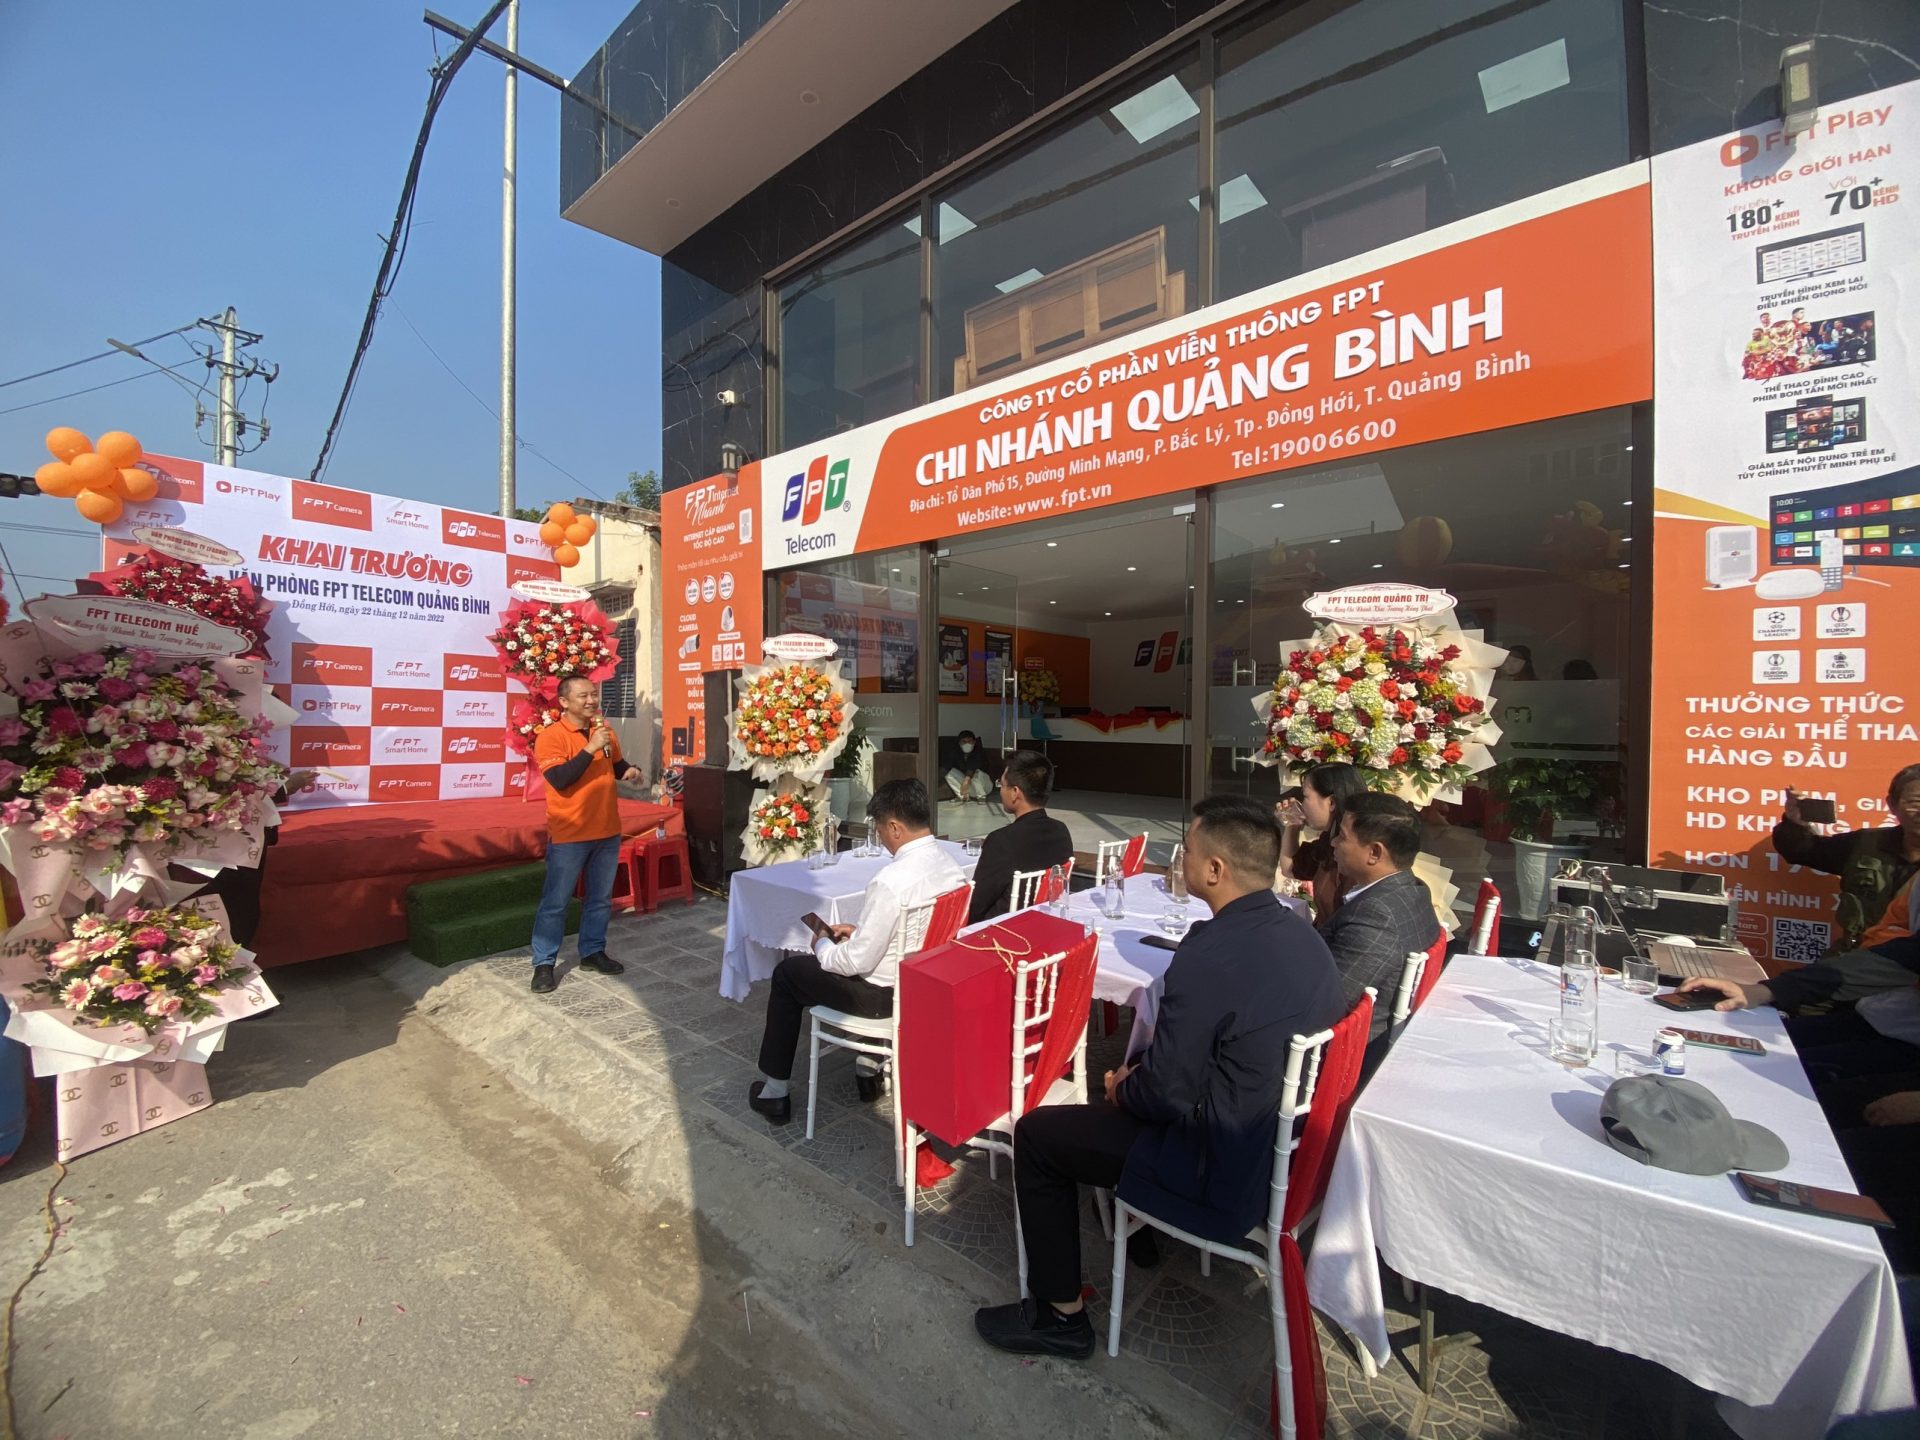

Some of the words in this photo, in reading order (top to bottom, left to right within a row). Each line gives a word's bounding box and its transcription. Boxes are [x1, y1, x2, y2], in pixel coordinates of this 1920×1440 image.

[1828, 105, 1893, 134] Play
[1724, 170, 1793, 196] KHÔNG
[1799, 155, 1842, 176] GIỚI
[1849, 143, 1892, 163] HẠN
[1873, 194, 1899, 207] HD
[1825, 279, 1846, 289] XEM
[979, 392, 1033, 424] CÔNG
[1036, 385, 1058, 408] TY
[1060, 364, 1092, 399] CỔ
[1099, 351, 1159, 389] PHẦN
[1165, 330, 1217, 368] VIỄN
[1226, 301, 1323, 350] THÔNG
[1332, 280, 1385, 317] FPT
[915, 444, 967, 488] CHI
[976, 401, 1113, 474] NHÁNH
[1127, 343, 1310, 433] QUẢNG
[1333, 287, 1504, 382] BÌNH
[1784, 379, 1811, 390] THAO
[1841, 371, 1865, 380] CAO
[1753, 393, 1777, 402] PHIM
[1780, 390, 1803, 399] BOM
[947, 485, 959, 504] Tổ
[962, 480, 983, 502] Dân
[985, 474, 1006, 498] Phố
[1007, 474, 1024, 492] 15,
[1025, 465, 1065, 488] Đường
[1069, 455, 1101, 477] Minh
[1105, 446, 1150, 473] Mạng,
[1154, 439, 1168, 457] P.
[1170, 426, 1199, 452] Bắc
[1205, 423, 1231, 446] Lý,
[1234, 418, 1263, 438] Tp.
[1266, 402, 1314, 429] Đồng
[1320, 391, 1361, 416] Hới,
[1364, 386, 1383, 406] T.
[1387, 367, 1462, 402] Quảng
[1475, 350, 1531, 381] Bình
[1819, 452, 1849, 462] DUNG
[1871, 448, 1885, 456] EM
[1830, 460, 1857, 469] MINH
[233, 485, 255, 496] FPT
[257, 489, 281, 502] Play
[782, 454, 851, 526] FPT
[685, 484, 716, 511] FPT
[712, 485, 740, 502] Internet
[302, 497, 335, 509] FPT
[334, 503, 363, 515] Camera
[136, 510, 174, 522] FPT
[386, 516, 407, 527] Smart
[408, 520, 430, 530] Home
[394, 510, 422, 522] FPT
[448, 521, 478, 538] FPT
[478, 530, 501, 539] Telecom
[525, 537, 539, 546] FPT
[785, 532, 836, 556] Telecom
[258, 533, 347, 571] KHAI
[350, 547, 472, 588] TRƯƠNG
[513, 569, 536, 579] FPT
[266, 572, 319, 596] PHÒNG
[323, 580, 350, 598] FPT
[352, 583, 414, 606] TELECOM
[417, 589, 459, 612] QUẢNG
[462, 595, 491, 615] BÌNH
[1327, 596, 1341, 604] FPT
[1344, 595, 1381, 604] TELECOM
[1383, 593, 1412, 603] QUẢNG
[291, 599, 317, 612] Đồng
[318, 601, 337, 613] Hới,
[339, 604, 360, 616] ngày
[361, 607, 372, 616] 22
[373, 608, 398, 620] tháng
[399, 611, 408, 619] 12
[409, 613, 426, 621] năm
[427, 614, 445, 623] 2022
[680, 613, 697, 623] CLOUD
[87, 607, 111, 620] FPT
[114, 612, 172, 631] TELECOM
[678, 623, 699, 633] CAMERA
[302, 659, 335, 668] FPT
[334, 663, 363, 671] Camera
[395, 661, 423, 670] FPT
[387, 669, 409, 677] Smart
[410, 670, 431, 678] Home
[449, 664, 479, 681] FPT
[319, 701, 339, 710] FPT
[340, 702, 362, 712] Play
[381, 703, 409, 712] FPT
[408, 705, 435, 713] Camera
[463, 702, 488, 710] FPT
[1685, 691, 1810, 714] THƯỞNG
[1820, 691, 1905, 714] THỨC
[456, 709, 476, 717] Smart
[1685, 723, 1733, 739] CÁC
[1740, 723, 1786, 739] GIẢI
[1795, 714, 1850, 741] THỂ
[301, 742, 334, 751] FPT
[332, 743, 362, 751] Camera
[393, 738, 421, 746] FPT
[448, 736, 478, 754] FPT
[385, 746, 406, 754] Smart
[1686, 744, 1773, 766] HÀNG
[1782, 742, 1848, 769] ĐẦU
[378, 780, 406, 788] FPT
[460, 773, 486, 781] FPT
[317, 782, 338, 791] FPT
[338, 782, 359, 792] Play
[453, 781, 473, 789] Smart
[1687, 786, 1750, 804] KHO
[1686, 811, 1726, 829] HD
[1684, 850, 1749, 869] HƠN
[1766, 889, 1821, 909] HÌNH
